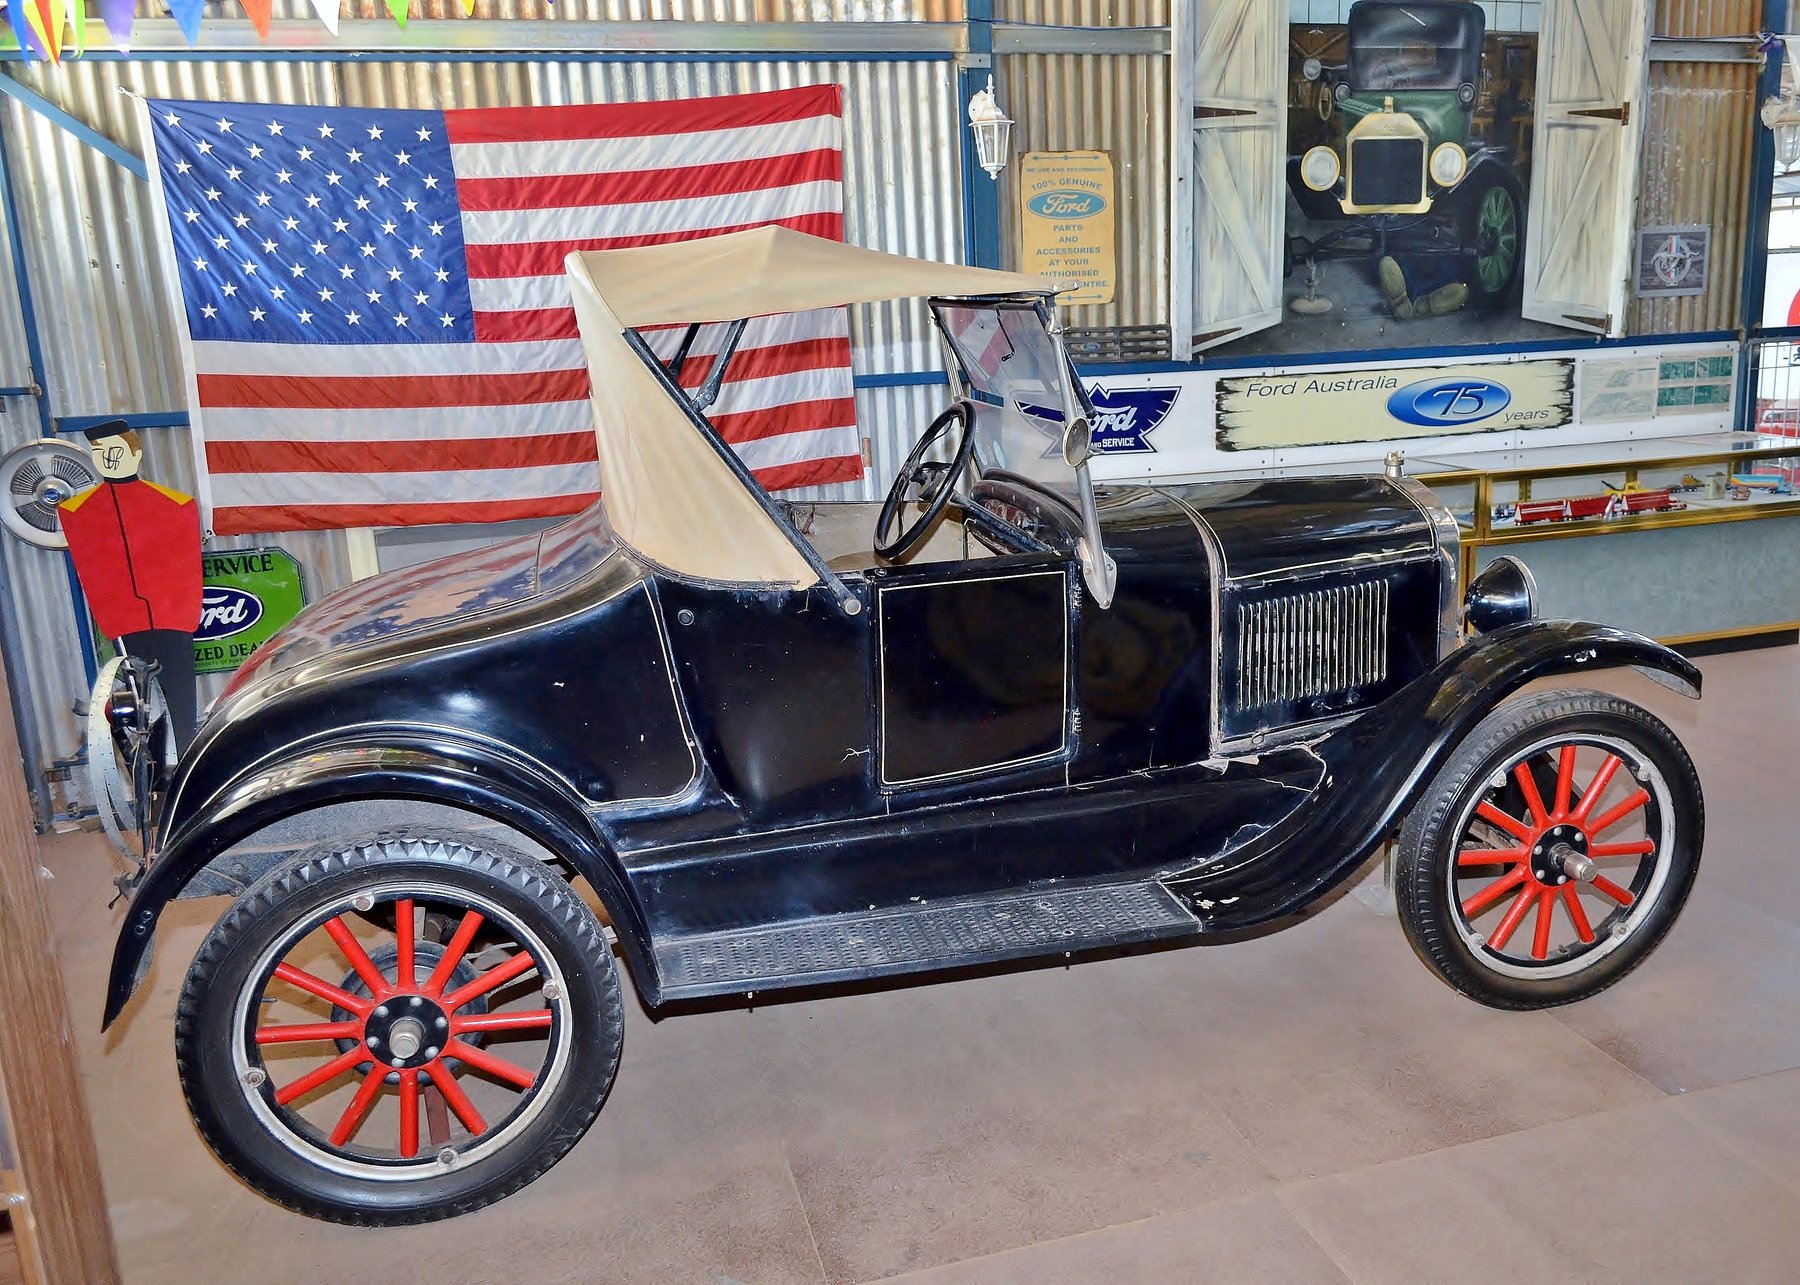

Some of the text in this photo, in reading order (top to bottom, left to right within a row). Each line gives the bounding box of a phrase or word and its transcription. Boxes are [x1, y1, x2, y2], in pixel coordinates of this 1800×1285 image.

[1059, 178, 1103, 190] GENUINE
[1042, 194, 1090, 213] Ford
[1036, 246, 1101, 255] ACCESSORIES
[1246, 375, 1398, 397] Ford Australia
[1433, 385, 1549, 424] 75 years
[1102, 437, 1135, 448] SERVICE
[202, 554, 274, 577] ERVICE
[195, 642, 260, 661] ZED DEA
